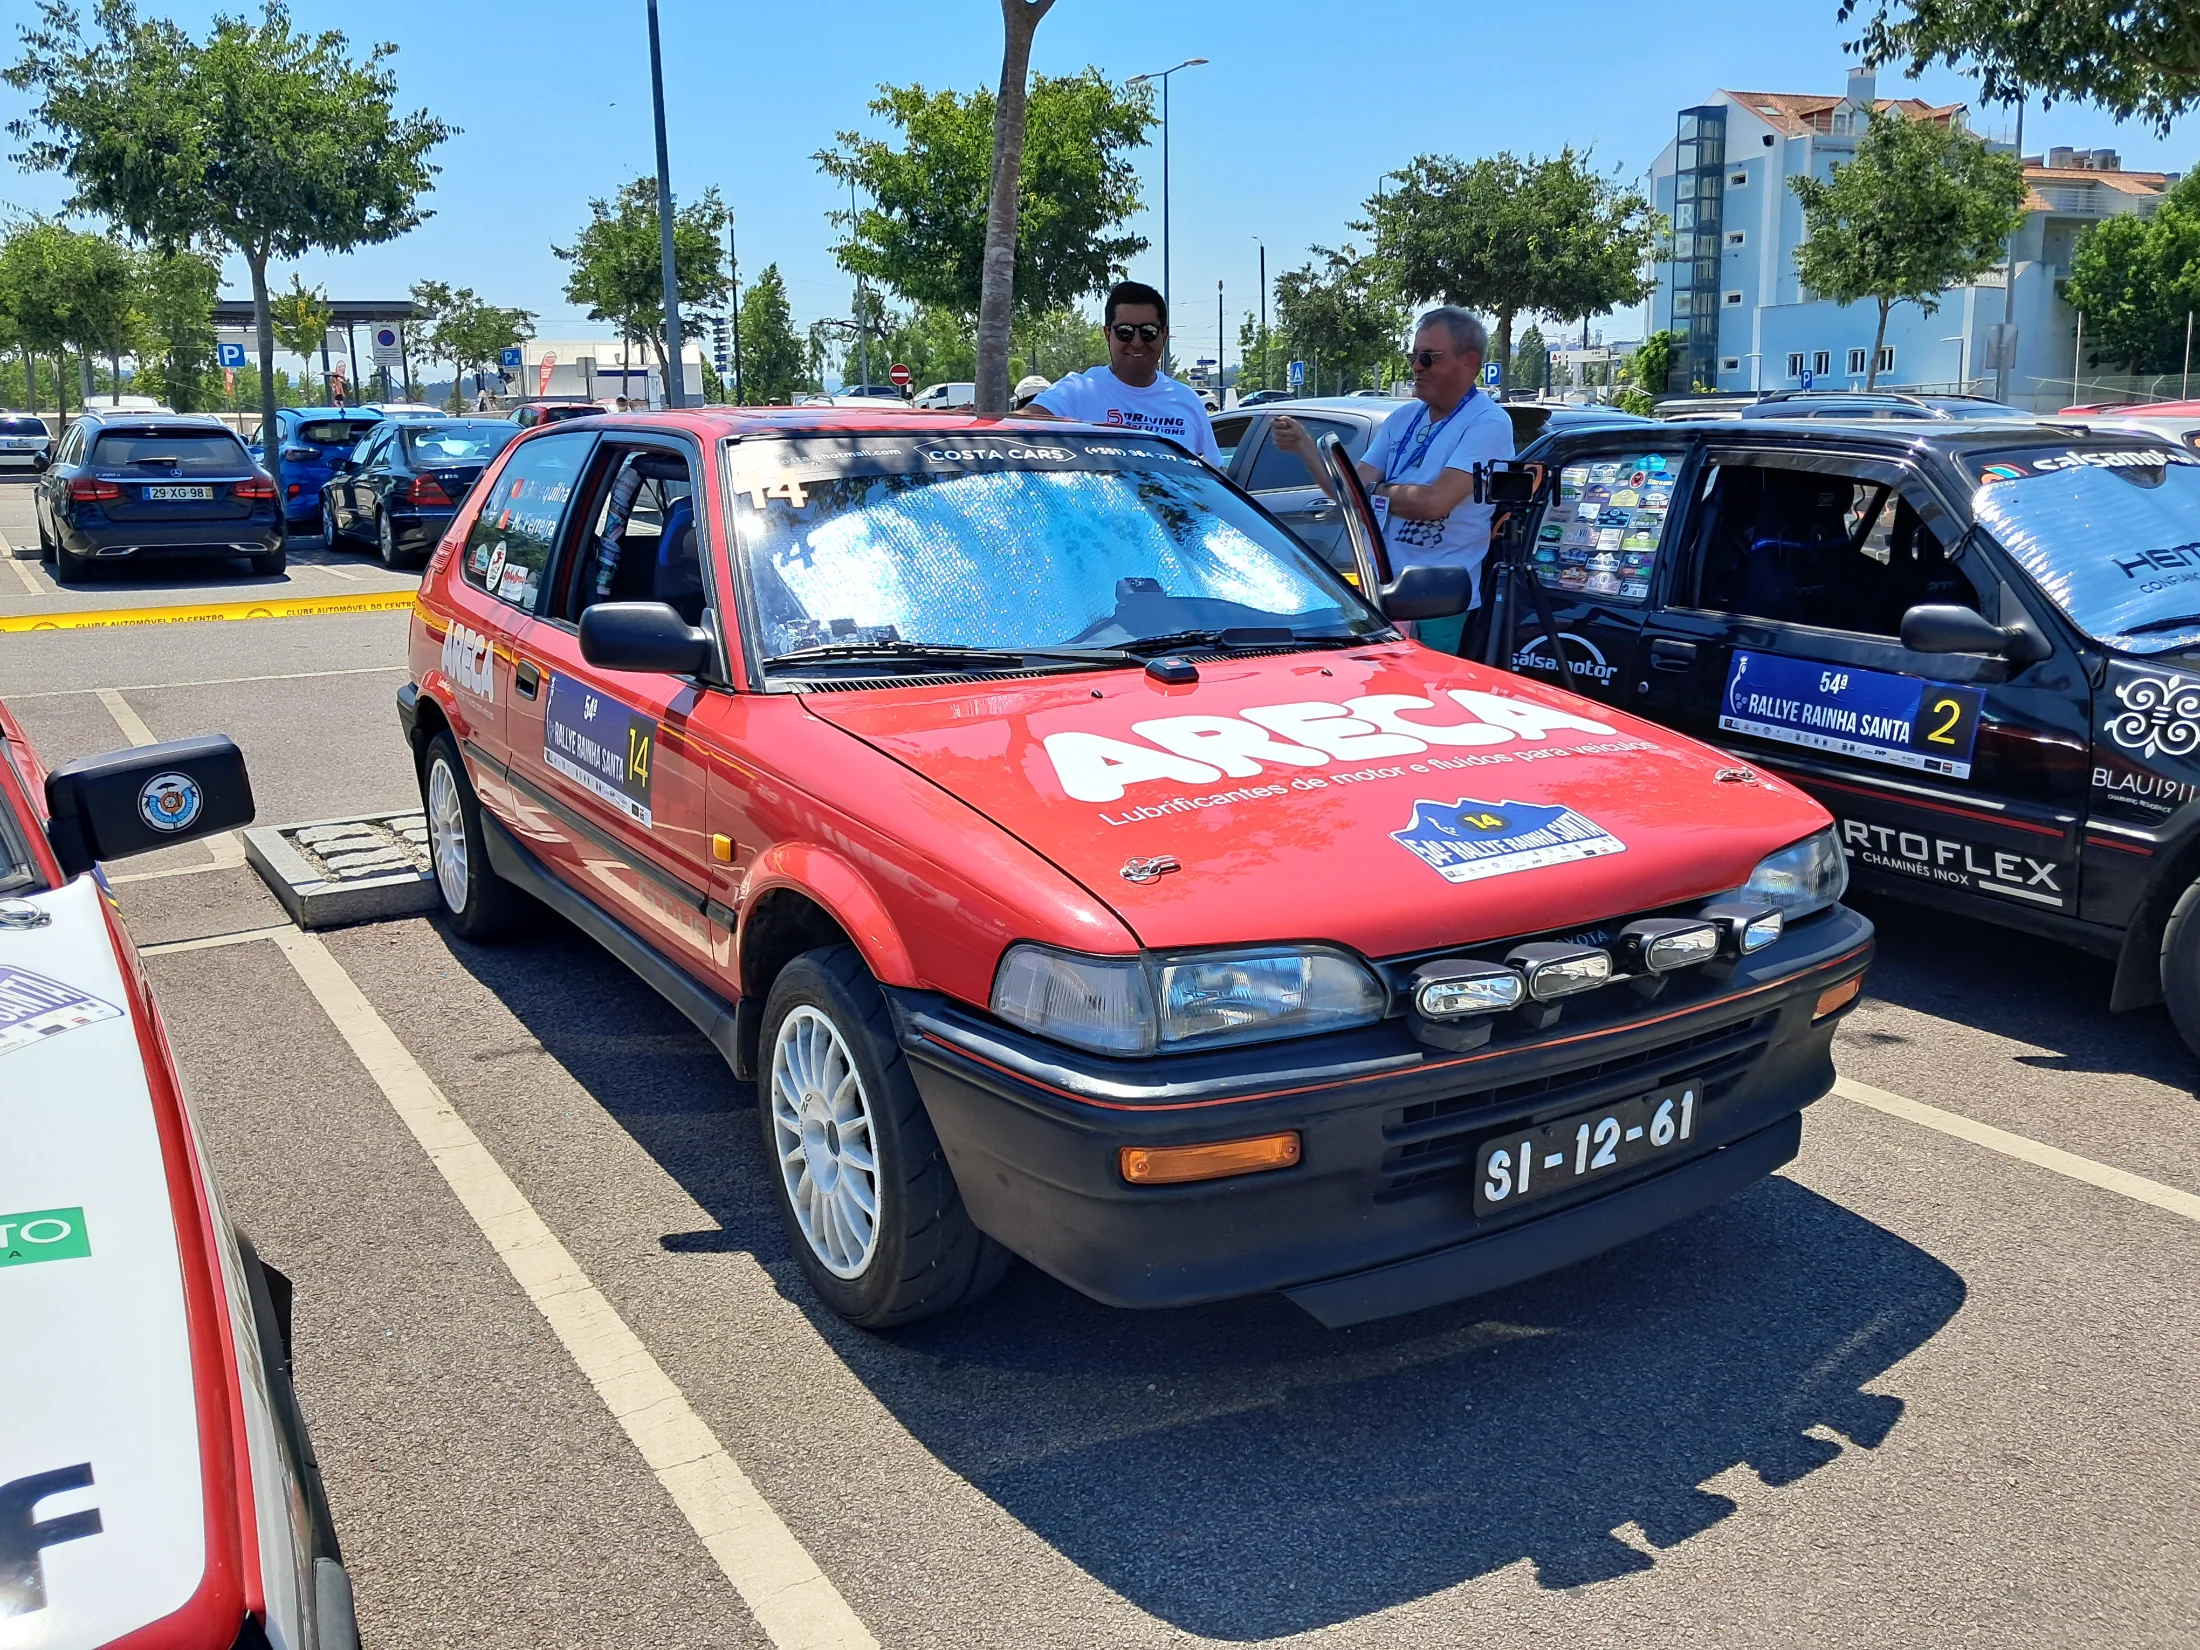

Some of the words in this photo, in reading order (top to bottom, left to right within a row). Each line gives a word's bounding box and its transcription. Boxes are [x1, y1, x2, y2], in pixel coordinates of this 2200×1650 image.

[223, 348, 238, 365] P
[1487, 366, 1497, 378] P
[1123, 411, 1185, 427] DRIVING
[929, 447, 1003, 461] COSTA
[1011, 449, 1063, 461] CARS
[187, 614, 224, 623] CENTRO
[441, 618, 494, 704] ARECA
[1748, 693, 1800, 723] RALLYE
[1801, 705, 1857, 734] RAINHA
[1859, 715, 1910, 745] SANTA
[1927, 699, 1961, 745] 2
[553, 721, 577, 755] RALLYE
[576, 730, 602, 772] RAINHA
[601, 744, 624, 783] SANTA
[628, 727, 649, 788] 14
[1042, 689, 1617, 803] ARECA
[1099, 782, 1288, 827] Lubrificantes
[1290, 777, 1329, 791] de
[1329, 764, 1407, 786] motor
[1409, 762, 1431, 774] e
[1512, 746, 1571, 762] para
[2092, 767, 2196, 803] BLAU1911
[1440, 838, 1512, 861] RALLYE
[1502, 830, 1562, 854] RAINHA
[1546, 811, 1608, 843] SANTA
[1464, 813, 1502, 830] 14
[1862, 851, 1930, 877] CHAMINÉS
[1934, 868, 1969, 885] INOX
[1484, 1090, 1694, 1201] SI-12-61
